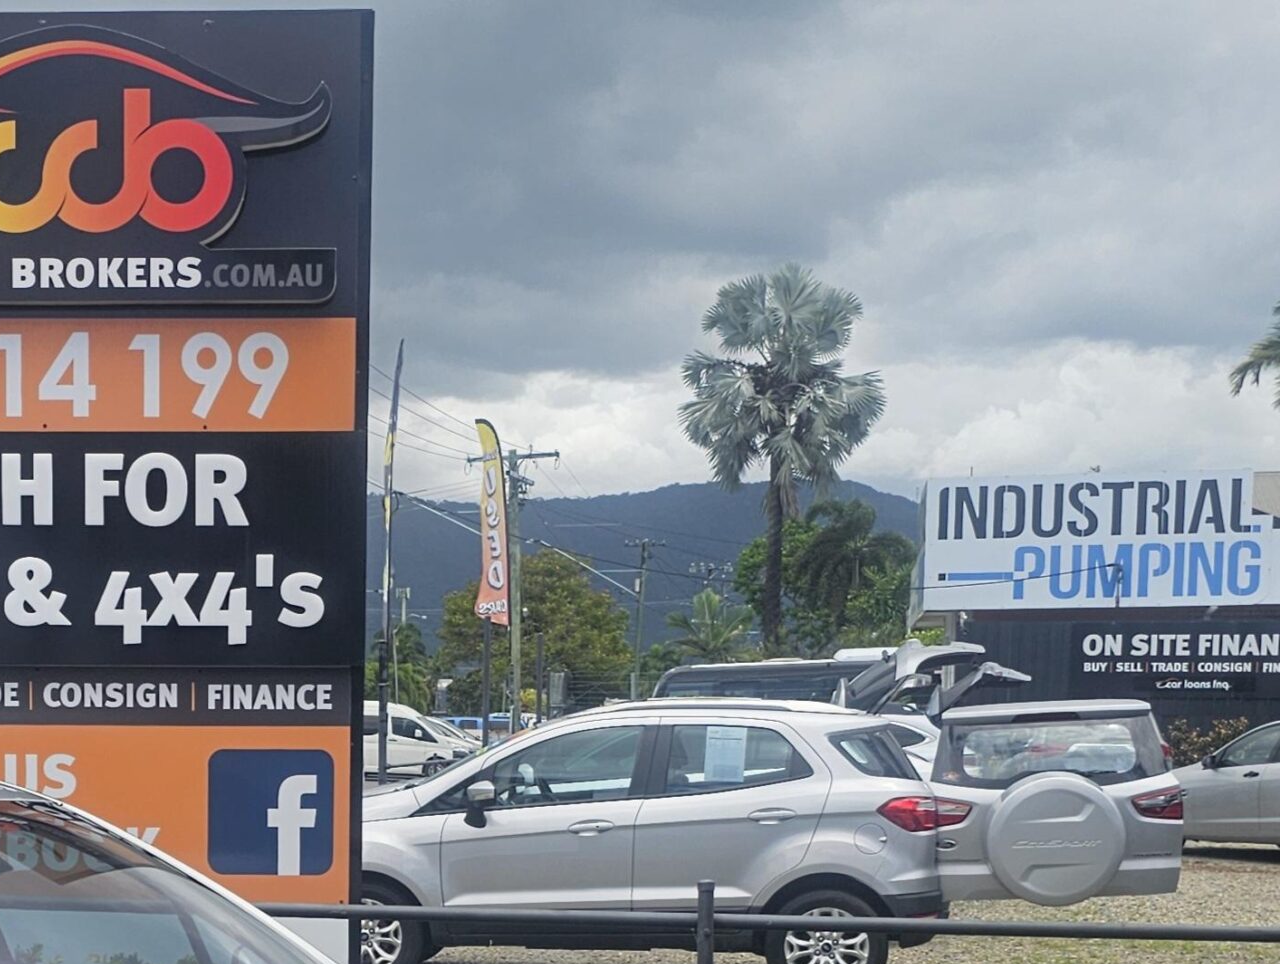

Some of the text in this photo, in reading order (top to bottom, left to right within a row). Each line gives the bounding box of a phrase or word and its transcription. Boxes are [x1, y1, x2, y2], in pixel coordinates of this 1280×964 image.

[128, 332, 289, 419] 199
[84, 452, 249, 527] FOR
[937, 478, 1253, 541] INDUSTRIAL
[3, 556, 72, 627] &
[1012, 540, 1262, 600] PUMPING
[1082, 633, 1280, 657] ON SITE FINAN
[1083, 661, 1108, 673] BUY
[1115, 661, 1144, 673] SELL
[1151, 661, 1189, 673] TRADE
[1197, 661, 1252, 673] CONSIGN
[43, 682, 178, 708] CONSIGN
[207, 684, 333, 711] FINANCE
[1184, 679, 1211, 689] loans
